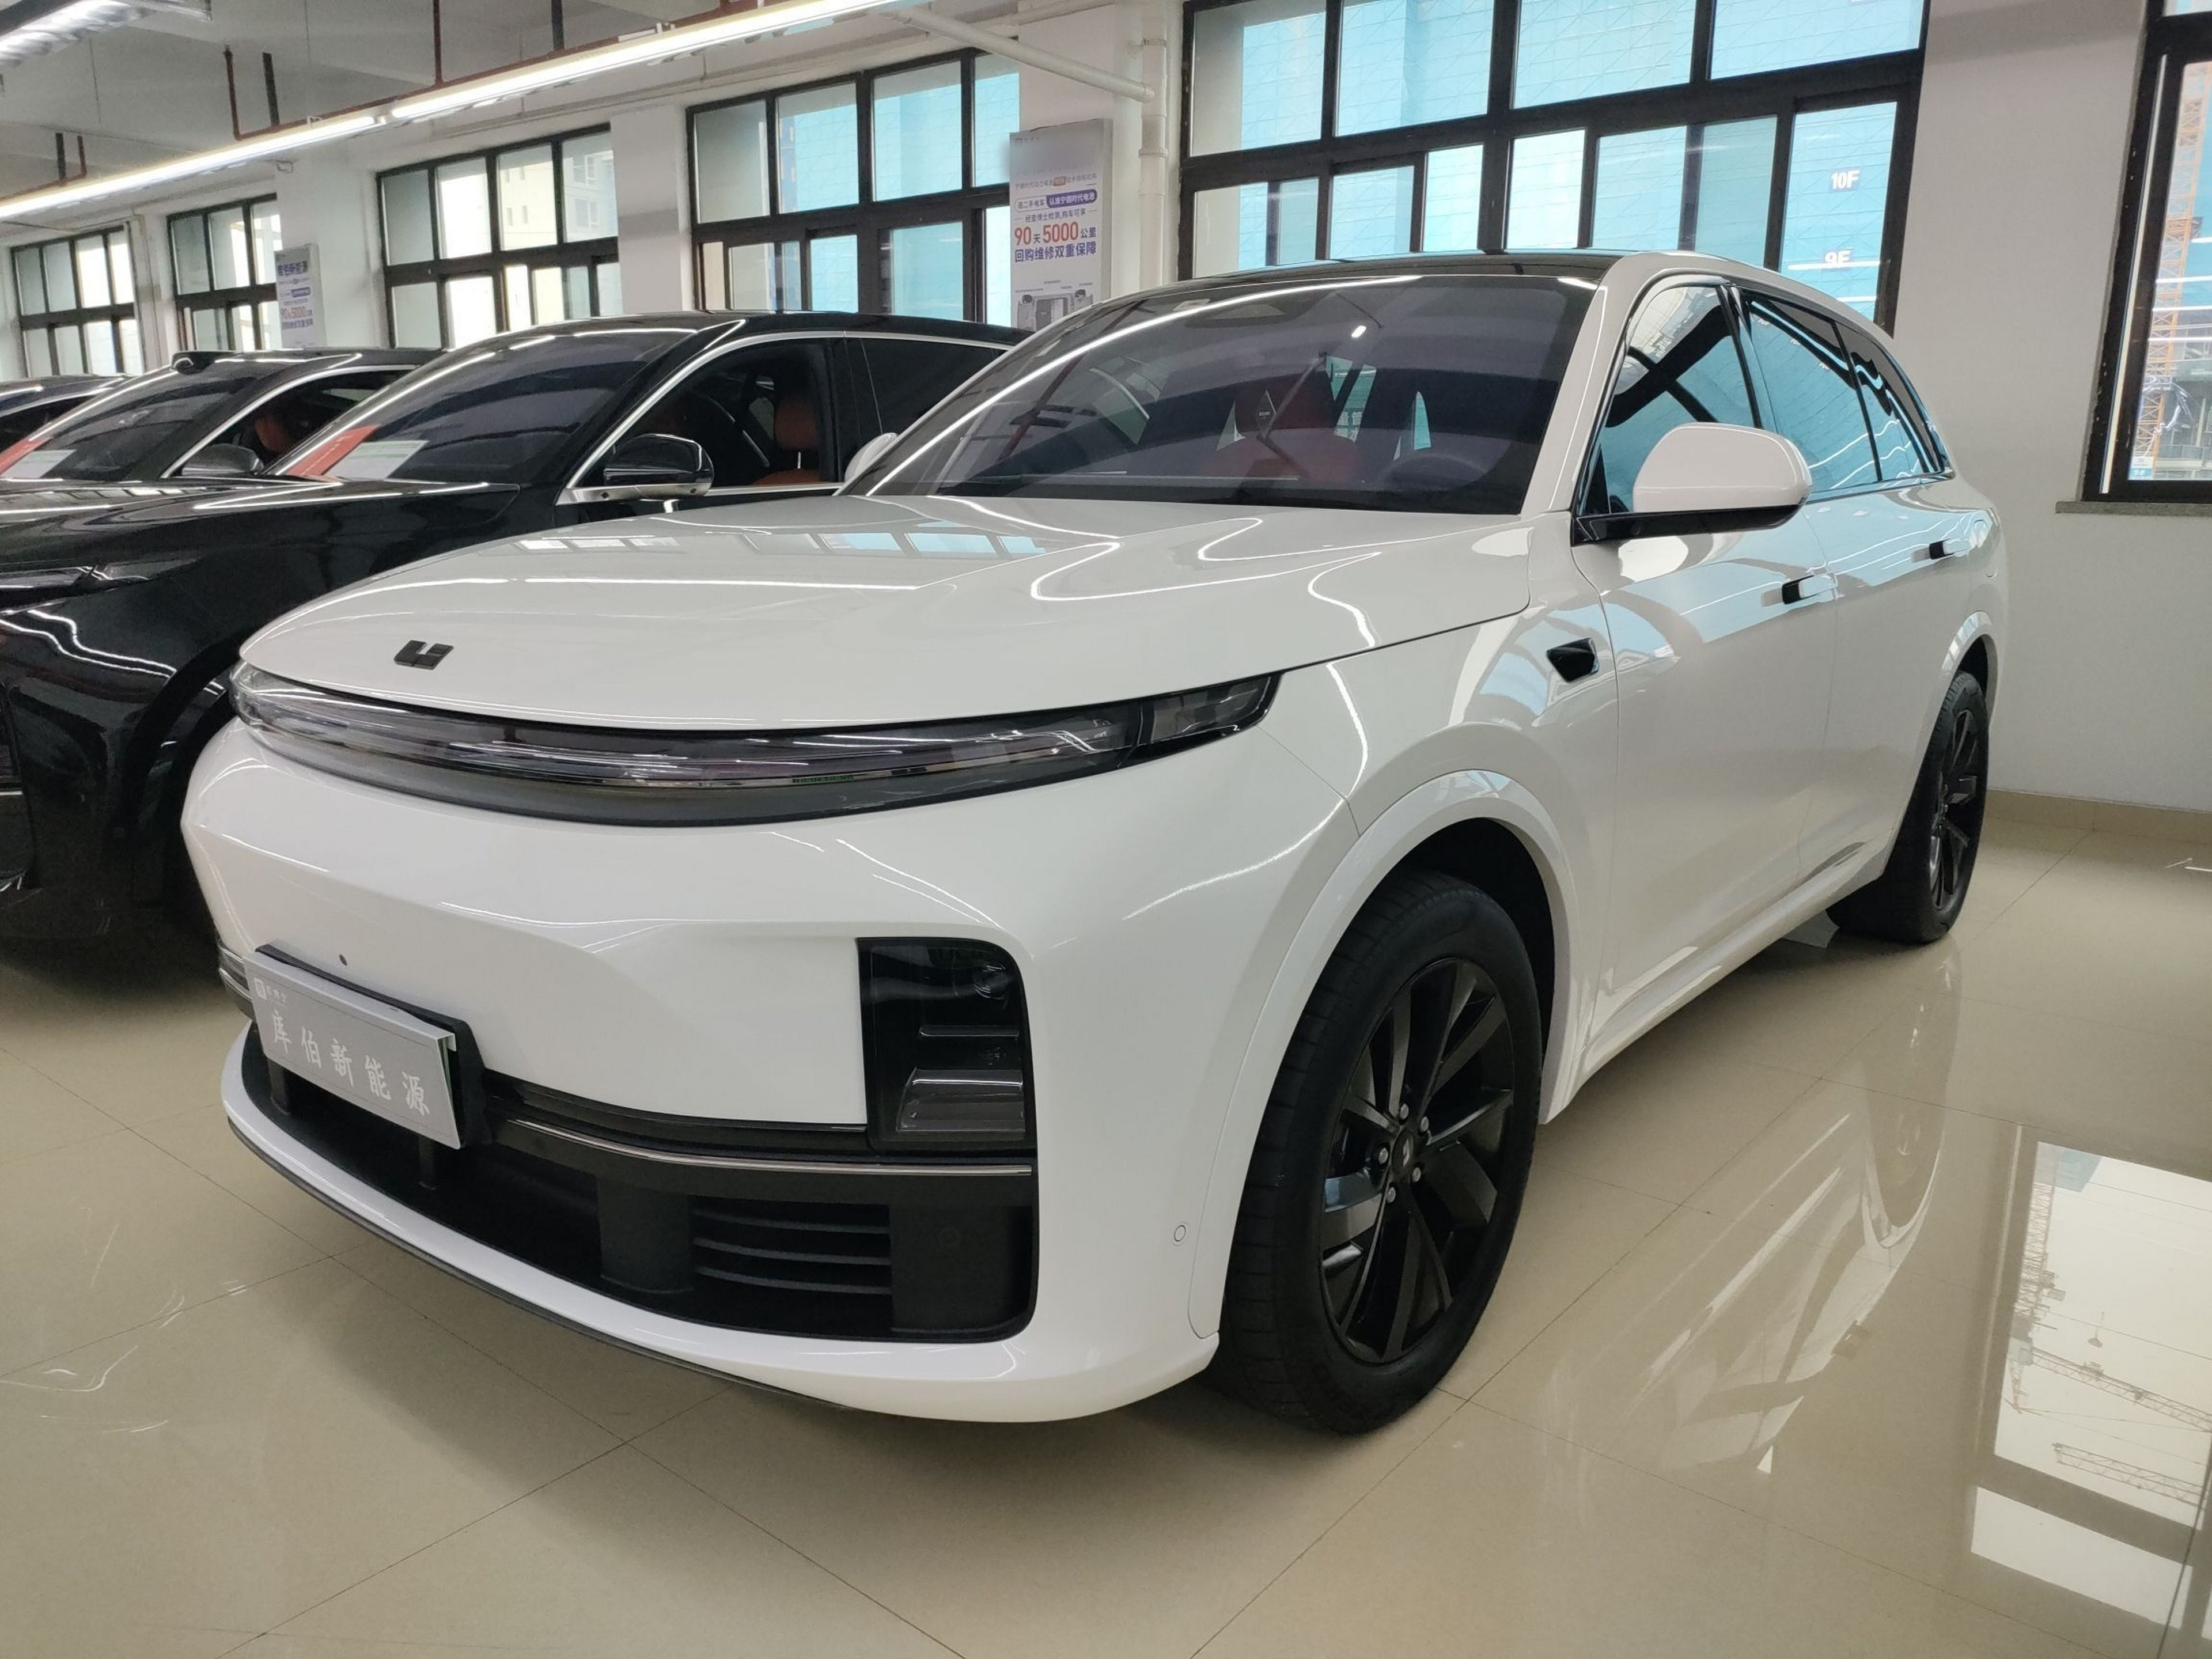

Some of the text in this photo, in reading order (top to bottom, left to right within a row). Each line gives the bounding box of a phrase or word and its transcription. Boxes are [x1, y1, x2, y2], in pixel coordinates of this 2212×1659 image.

[1831, 170, 1860, 190] 10F
[1014, 241, 1097, 263] 回购维修双重保障
[271, 1010, 430, 1116] 库伯新能源
